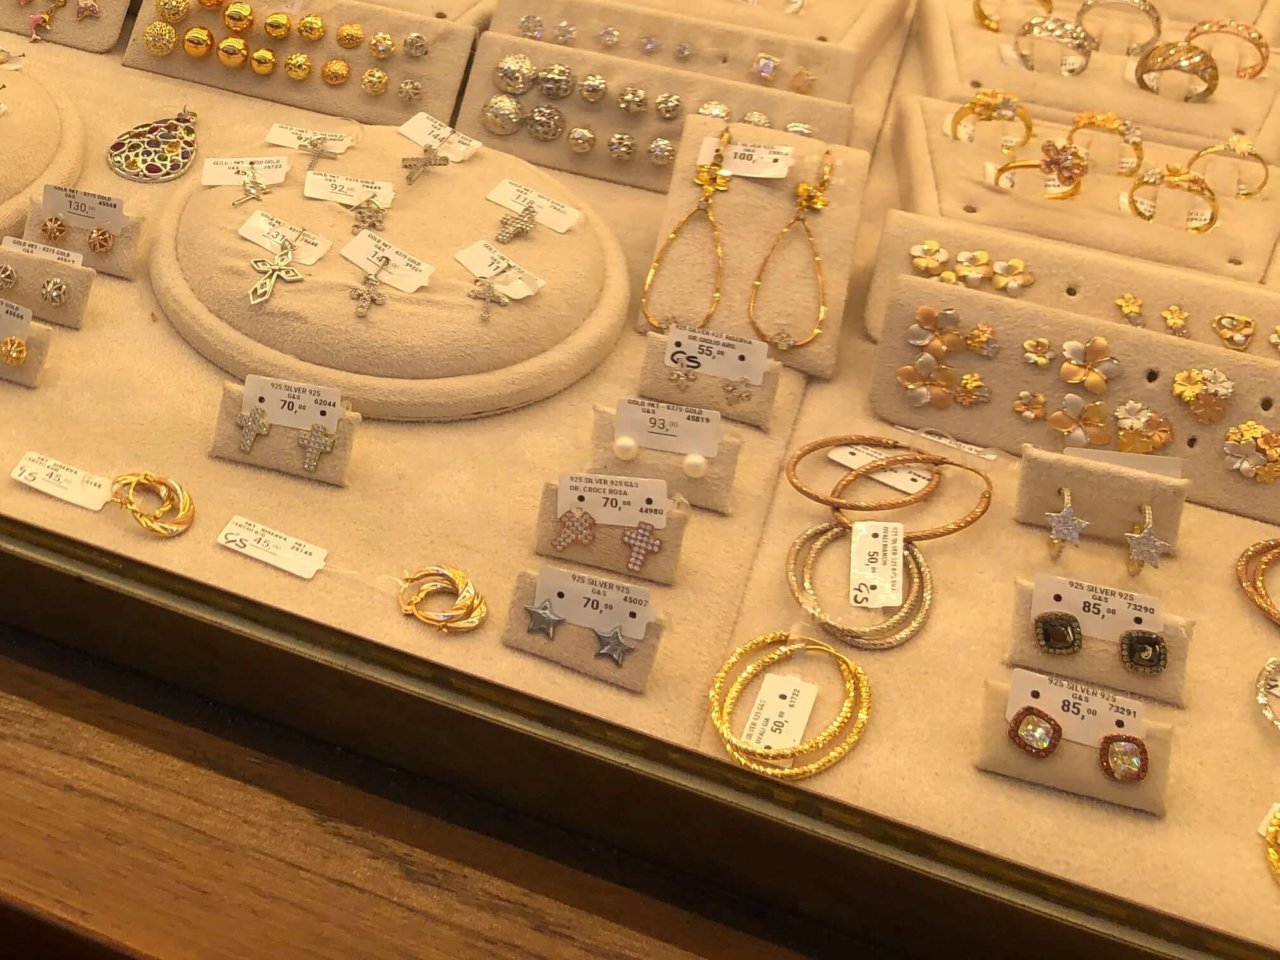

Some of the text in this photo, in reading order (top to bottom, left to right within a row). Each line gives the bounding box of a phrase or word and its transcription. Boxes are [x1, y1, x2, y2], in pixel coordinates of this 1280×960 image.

[284, 384, 308, 395] SILVER
[309, 389, 322, 397] 925
[584, 477, 609, 486] SILVER
[583, 485, 608, 494] CROCE
[571, 574, 630, 594] 925 SILVER 925
[1068, 580, 1135, 601] 925 SILVER 925
[1048, 677, 1117, 703] 925 SILVER 925
[1108, 703, 1137, 718] 73291
